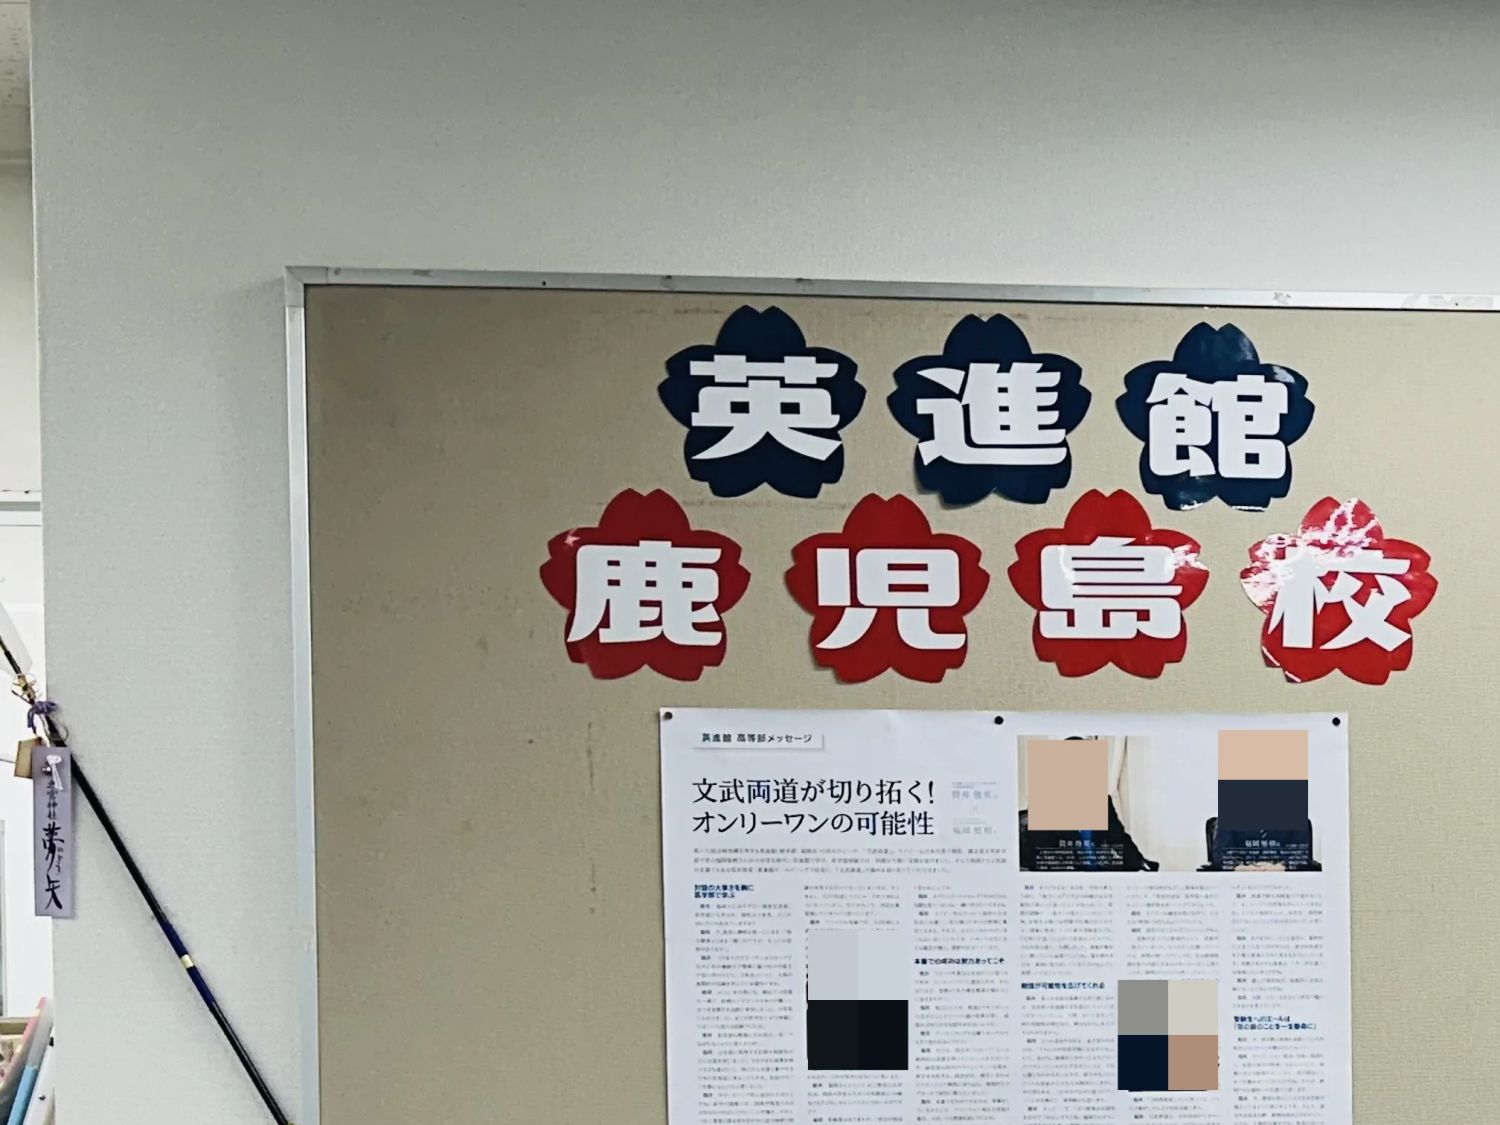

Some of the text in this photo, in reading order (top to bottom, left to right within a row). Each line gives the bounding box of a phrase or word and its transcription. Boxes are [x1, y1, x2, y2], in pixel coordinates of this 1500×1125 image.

[690, 353, 1290, 480] 英進館
[567, 536, 1412, 653] 鹿児島校
[691, 811, 935, 836] オンリーワンの可能性
